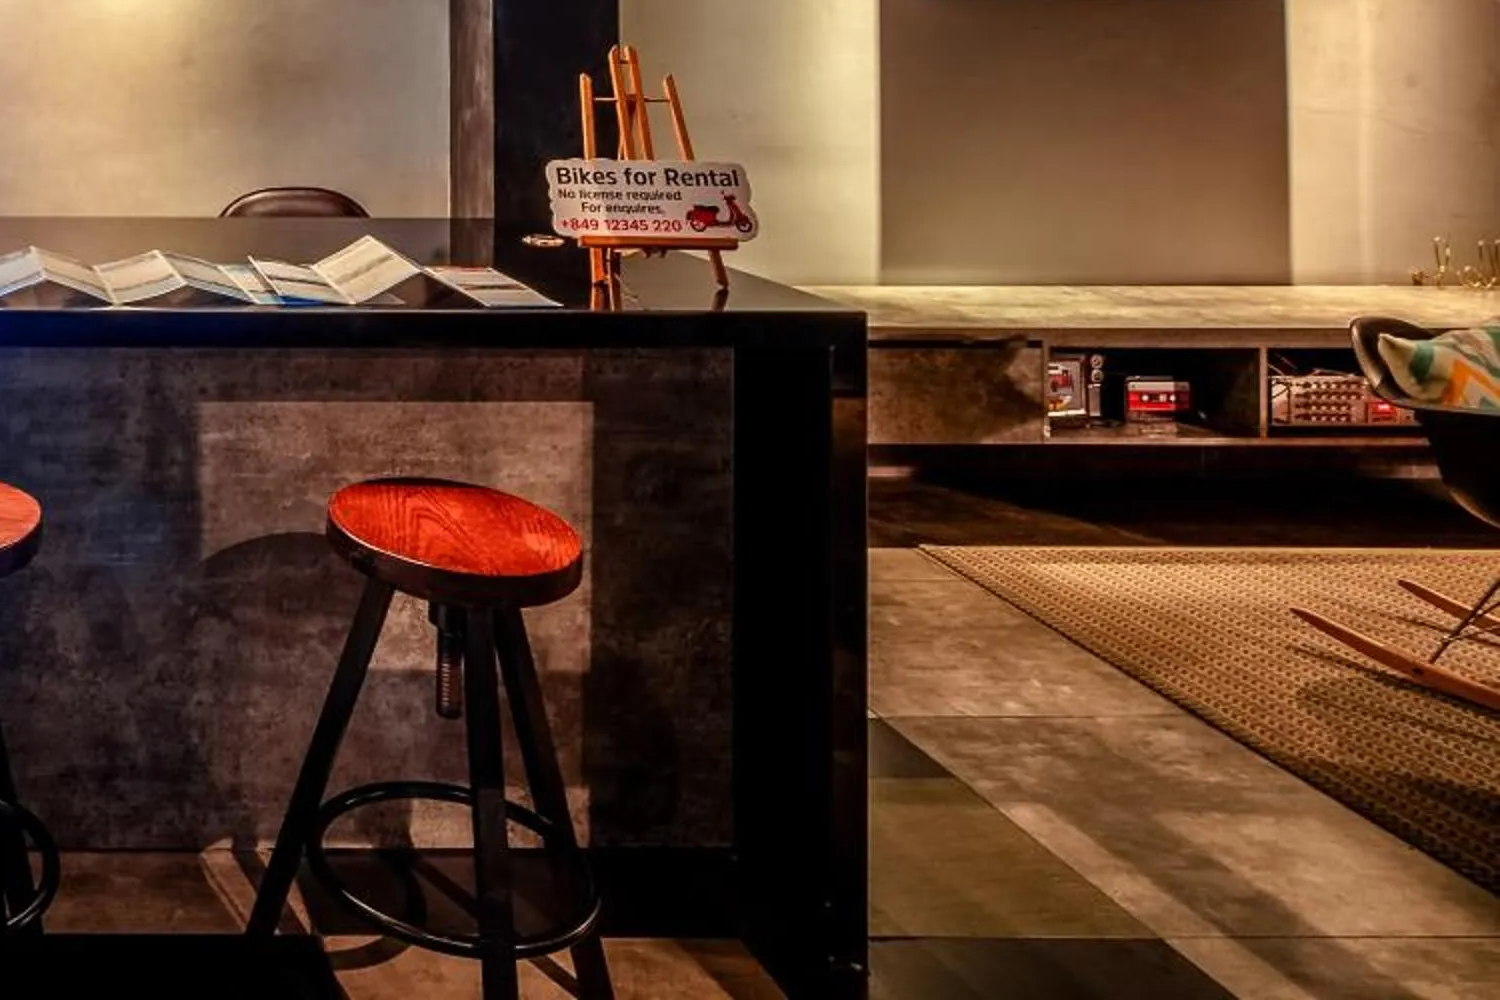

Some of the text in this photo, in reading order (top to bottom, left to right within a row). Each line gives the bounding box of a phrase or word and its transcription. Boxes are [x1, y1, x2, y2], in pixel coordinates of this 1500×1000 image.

[556, 166, 740, 188] Bikes for Rental
[558, 189, 576, 199] No
[580, 189, 623, 201] license
[581, 202, 602, 213] For
[562, 218, 682, 232] +849 12345 220
